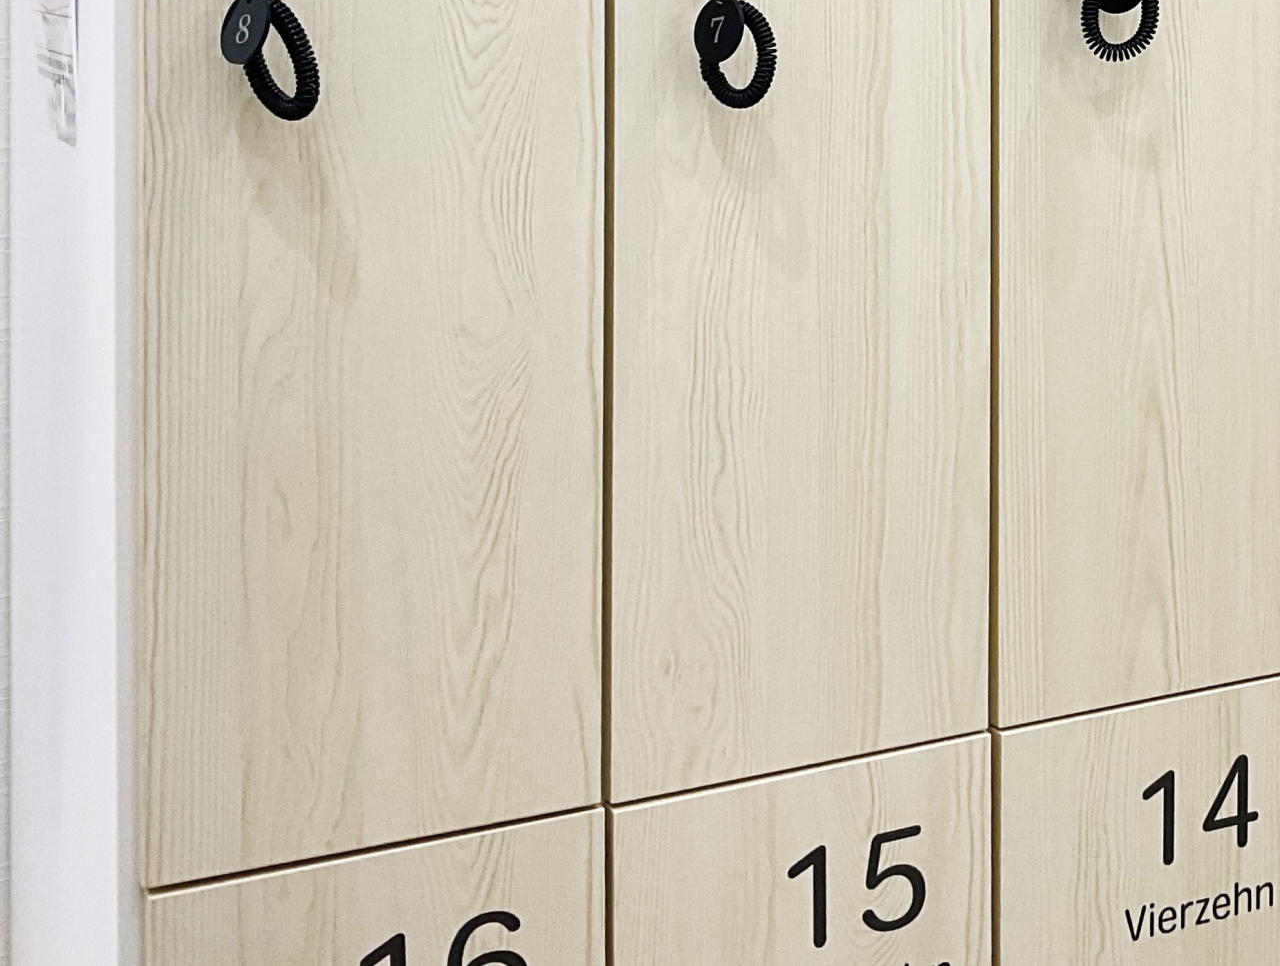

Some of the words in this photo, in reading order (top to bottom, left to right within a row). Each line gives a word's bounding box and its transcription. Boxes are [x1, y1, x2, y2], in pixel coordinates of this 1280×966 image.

[234, 12, 252, 45] 8
[709, 15, 726, 44] 7
[1142, 754, 1259, 866] 14
[787, 824, 927, 949] 15
[1124, 881, 1274, 942] Vierzehn
